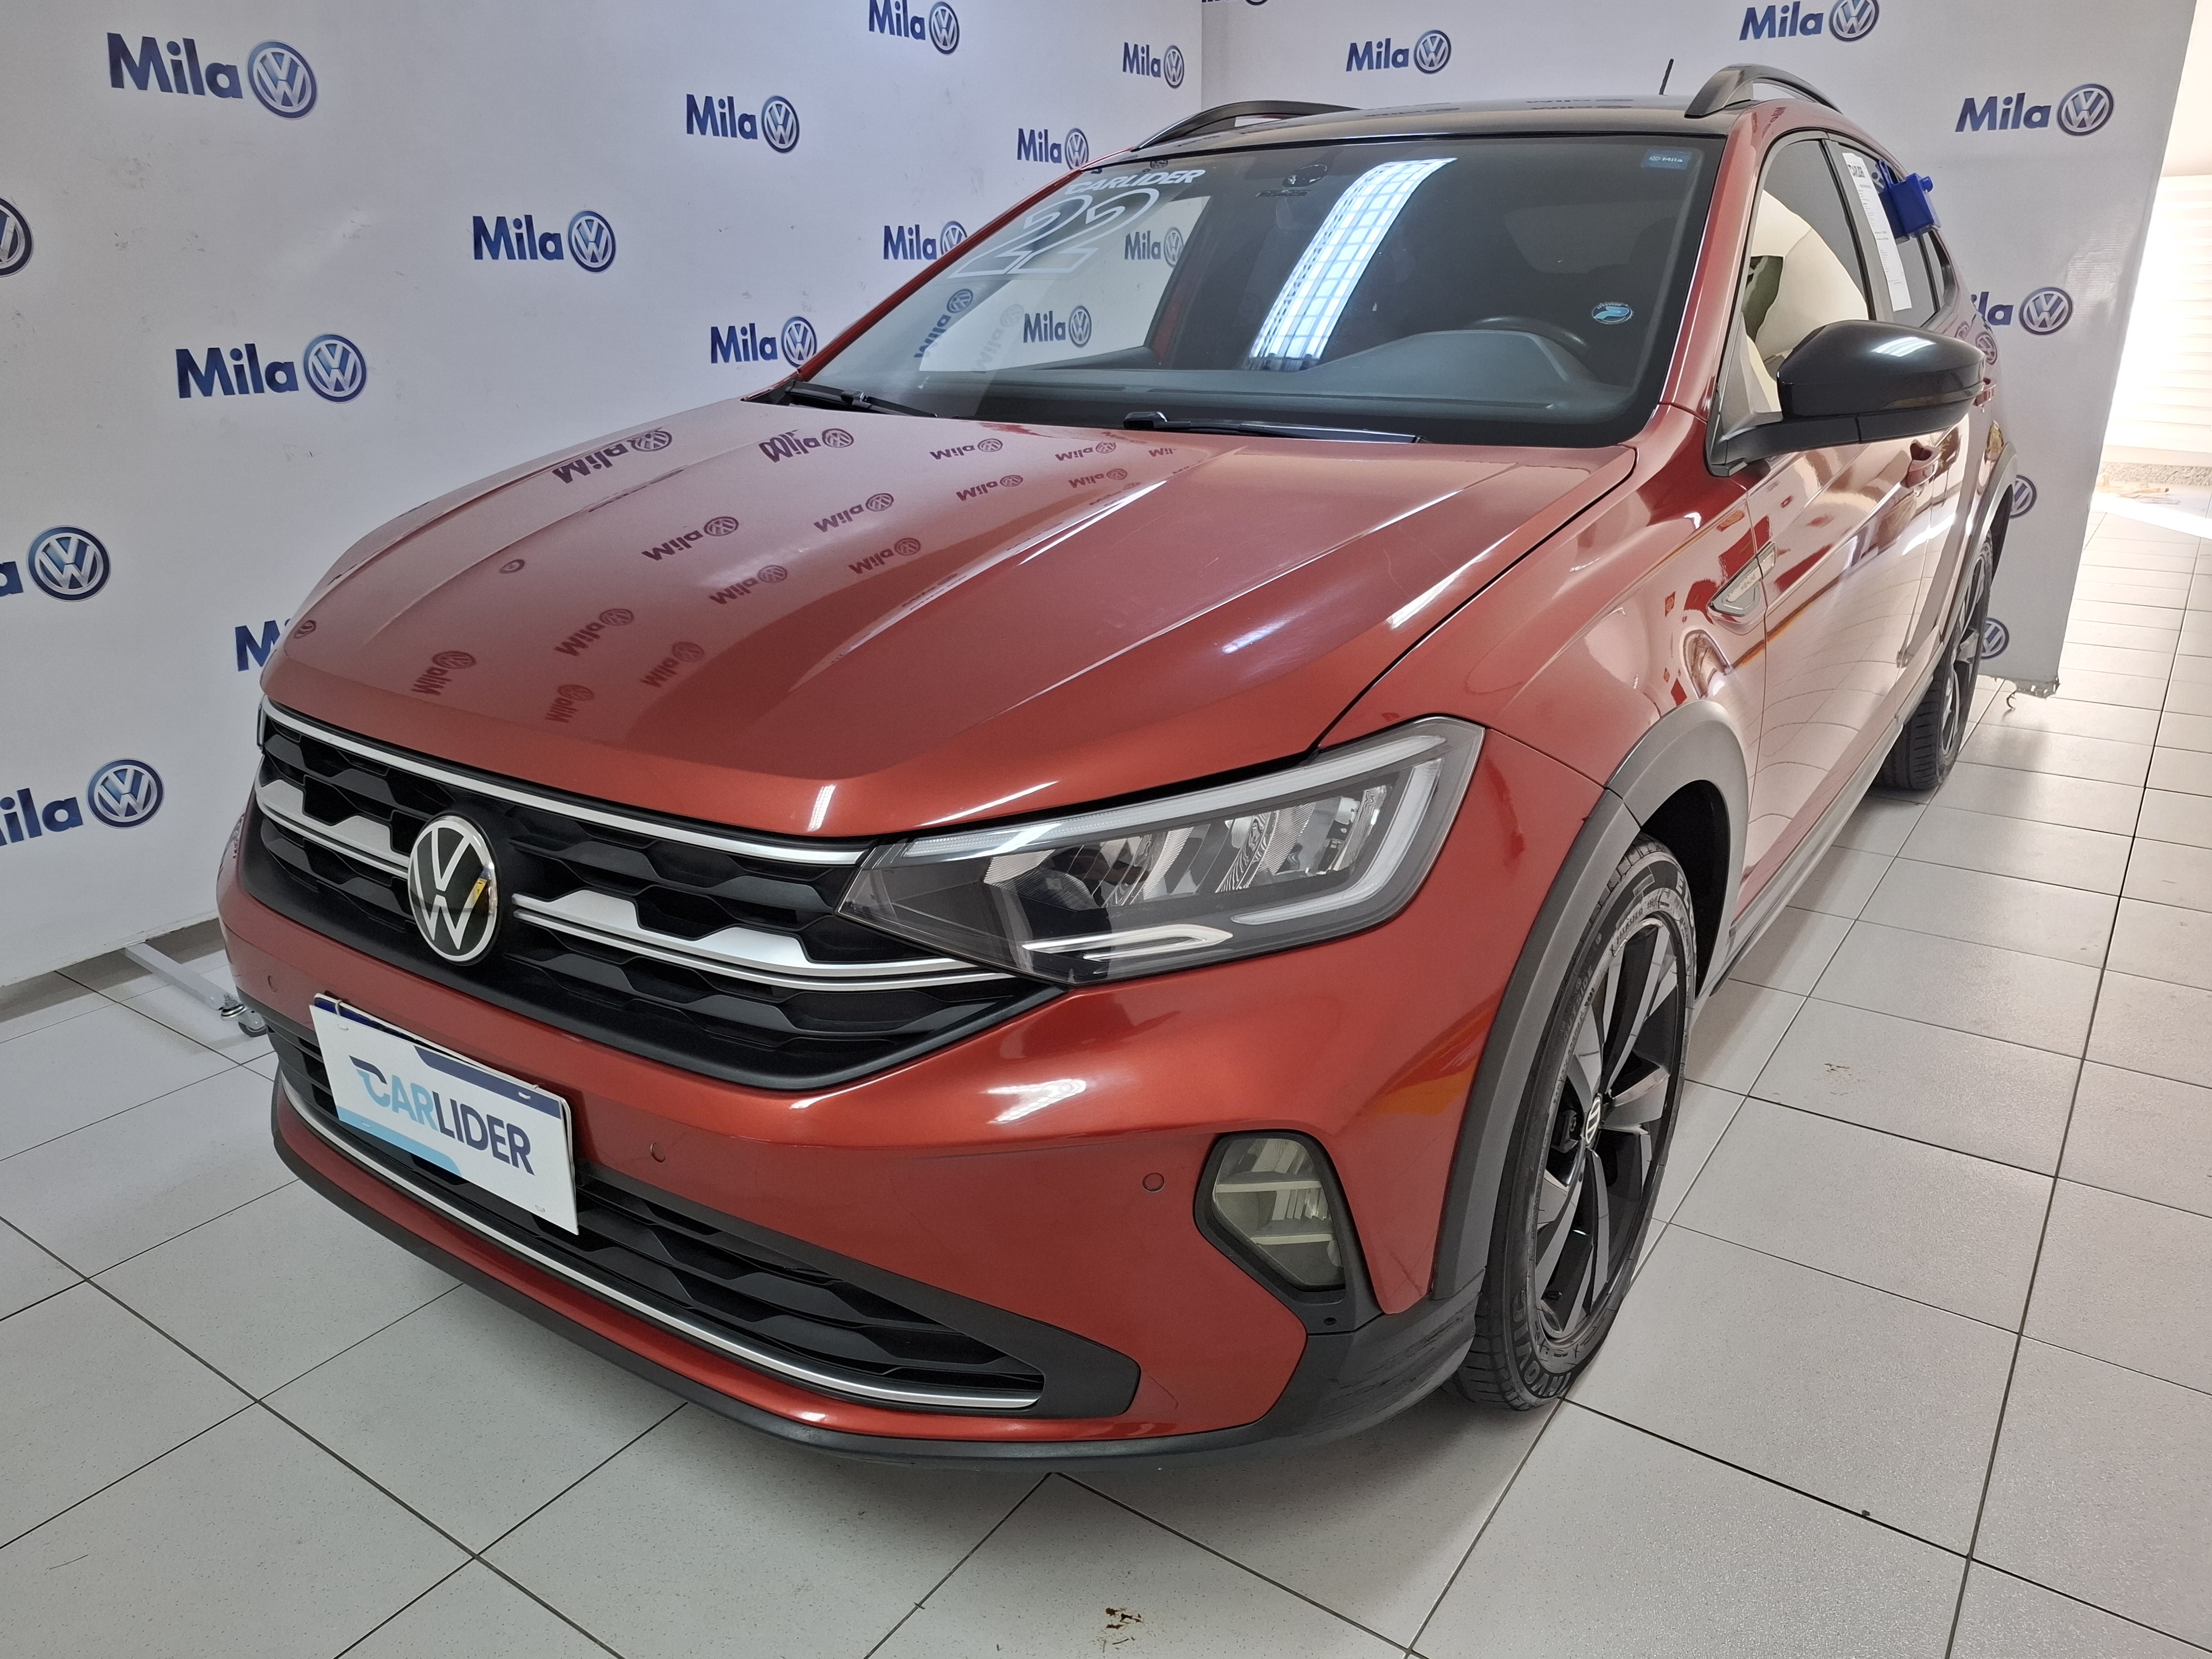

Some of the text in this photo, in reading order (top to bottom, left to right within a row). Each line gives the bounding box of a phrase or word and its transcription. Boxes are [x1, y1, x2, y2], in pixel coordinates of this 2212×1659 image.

[868, 0, 926, 41] Mila
[1739, 1, 1824, 41] Mila
[107, 32, 243, 99] Mila
[1122, 42, 1161, 78] Mila
[1346, 37, 1410, 72] Mila
[686, 94, 758, 140] Mila
[1955, 92, 2052, 132] Mila
[1017, 128, 1062, 164] Mila
[1064, 169, 1206, 195] CARLIDER
[472, 214, 564, 261] Mila
[883, 224, 937, 260] Mila
[1124, 230, 1161, 260] Mila
[1023, 310, 1066, 343] Mila
[1971, 291, 2014, 326] la
[710, 323, 778, 364] Mila
[175, 343, 299, 399] Mila
[0, 787, 83, 847] ila
[348, 1054, 535, 1176] CARLIDER
